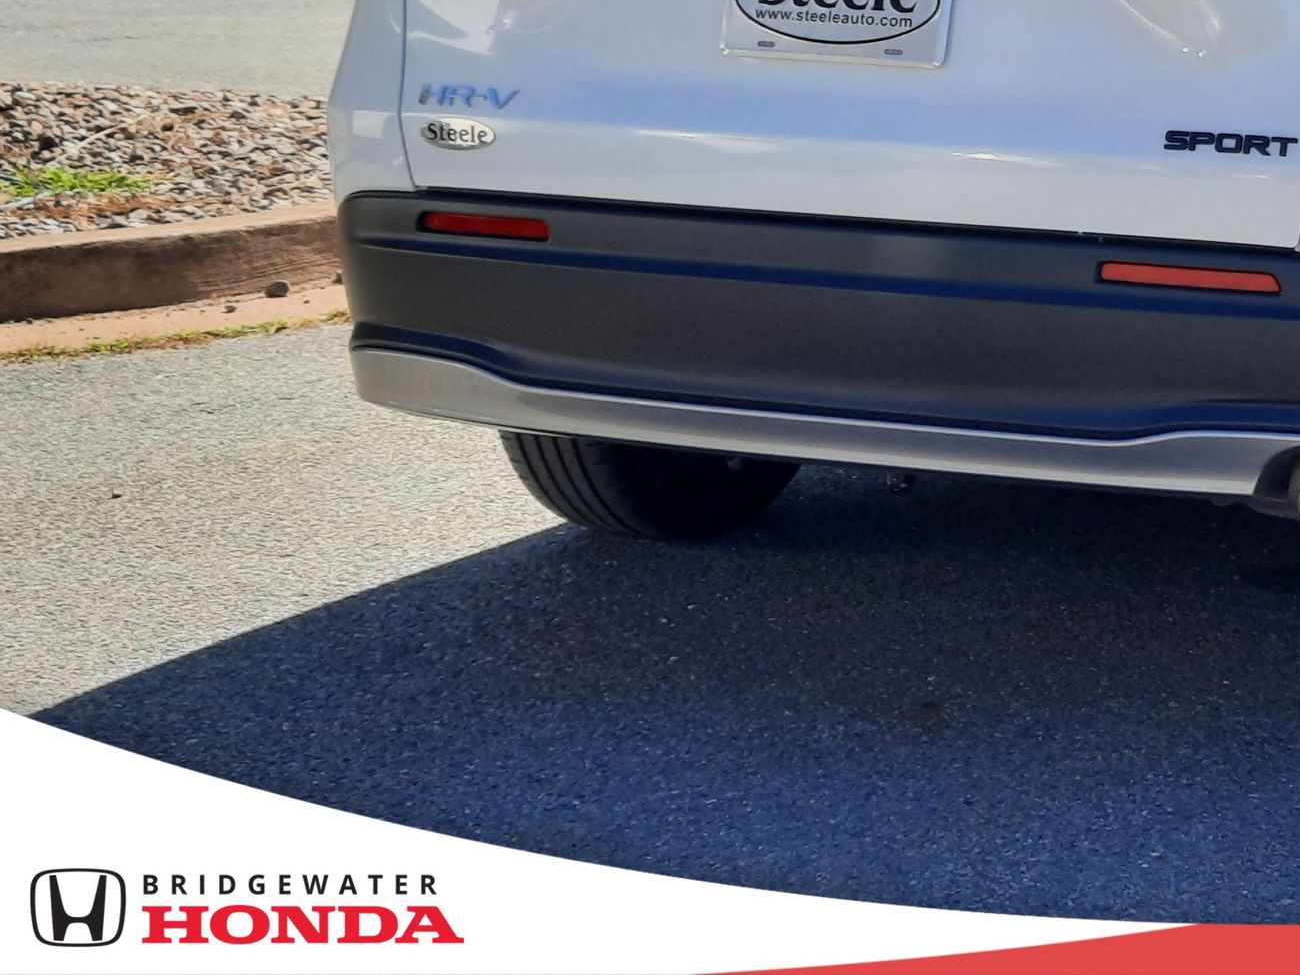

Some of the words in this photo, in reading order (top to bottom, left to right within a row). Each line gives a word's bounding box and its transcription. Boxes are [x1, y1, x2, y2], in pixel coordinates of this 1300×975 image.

[755, 9, 913, 27] www.steeleauto.com
[418, 84, 520, 110] HR-V
[427, 123, 488, 144] Steele
[1163, 130, 1299, 157] SPORT
